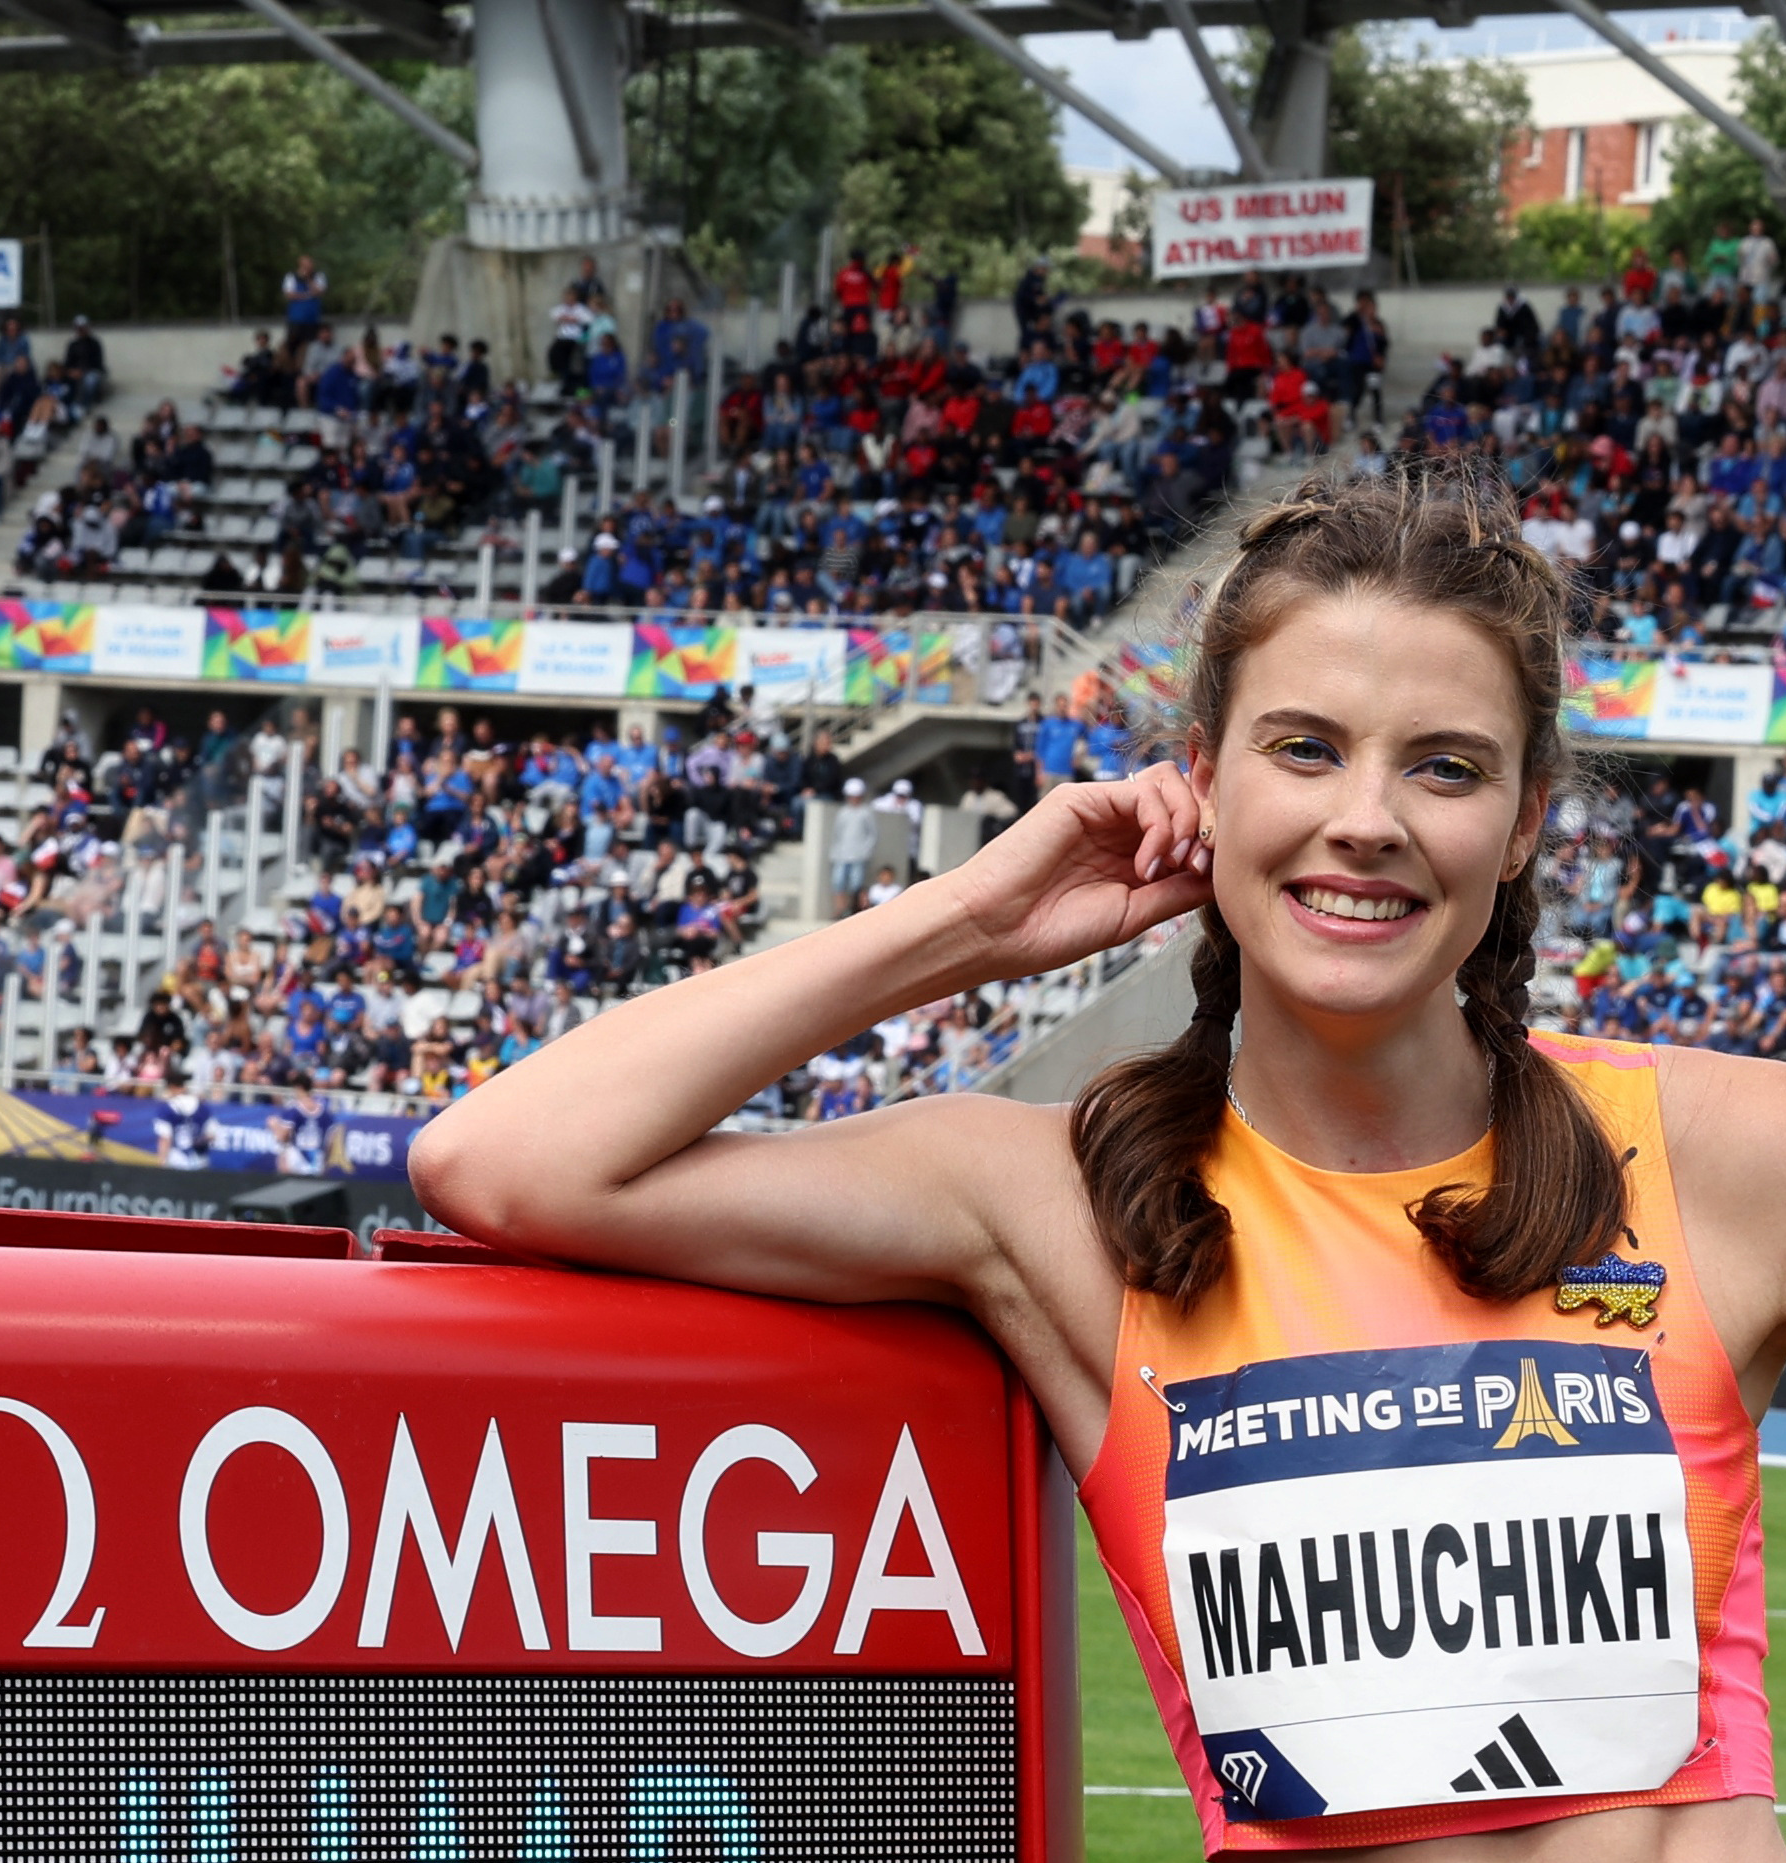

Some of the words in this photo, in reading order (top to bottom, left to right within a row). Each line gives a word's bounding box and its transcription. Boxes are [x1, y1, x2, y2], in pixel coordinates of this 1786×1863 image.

[1165, 229, 1362, 265] ATHLETISME
[1180, 197, 1222, 223] US
[1234, 189, 1346, 219] MELUN
[1177, 1390, 1401, 1461] MEETING
[1413, 1384, 1464, 1424] DE
[1475, 1358, 1651, 1448] PARIS
[179, 1405, 988, 1659] OMEGA
[1189, 1513, 1671, 1680] MAHUCHIKH
